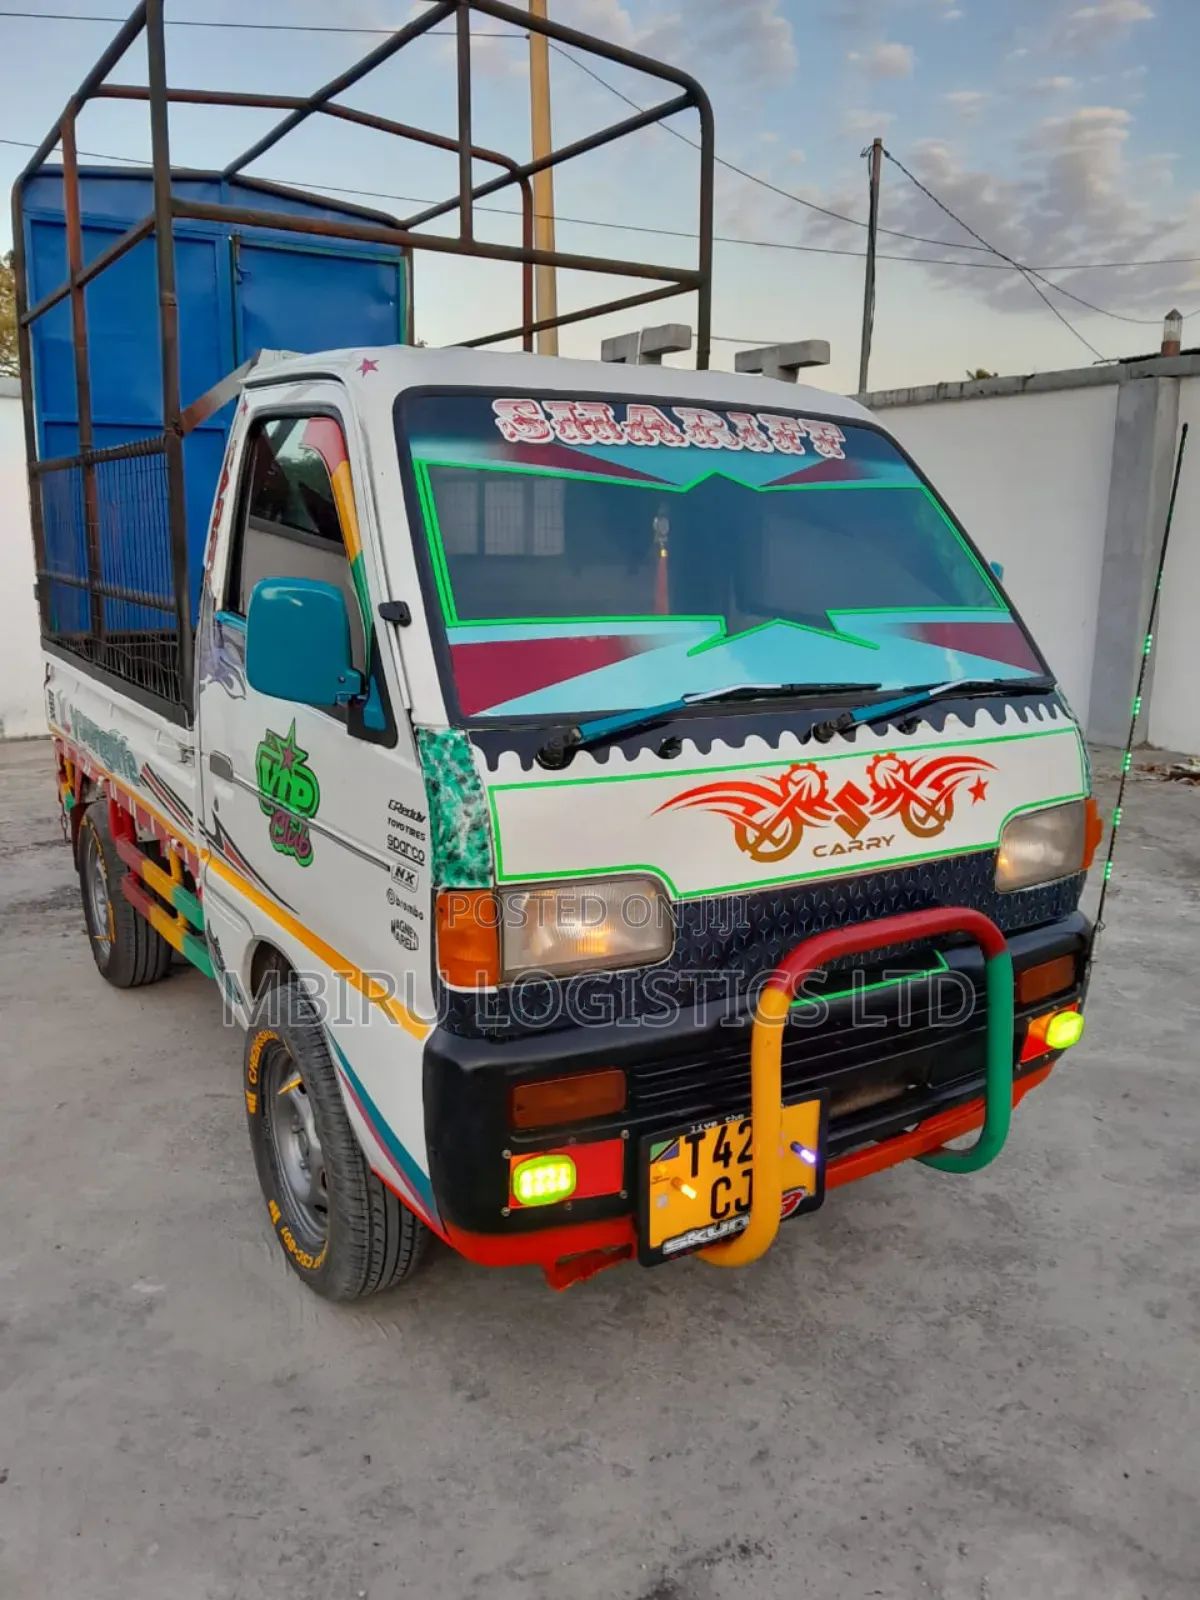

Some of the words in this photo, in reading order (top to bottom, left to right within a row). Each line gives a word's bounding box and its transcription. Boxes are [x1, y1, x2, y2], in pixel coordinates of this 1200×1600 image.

[812, 834, 896, 858] CARRY
[689, 1120, 718, 1135] live
[724, 1113, 745, 1123] the
